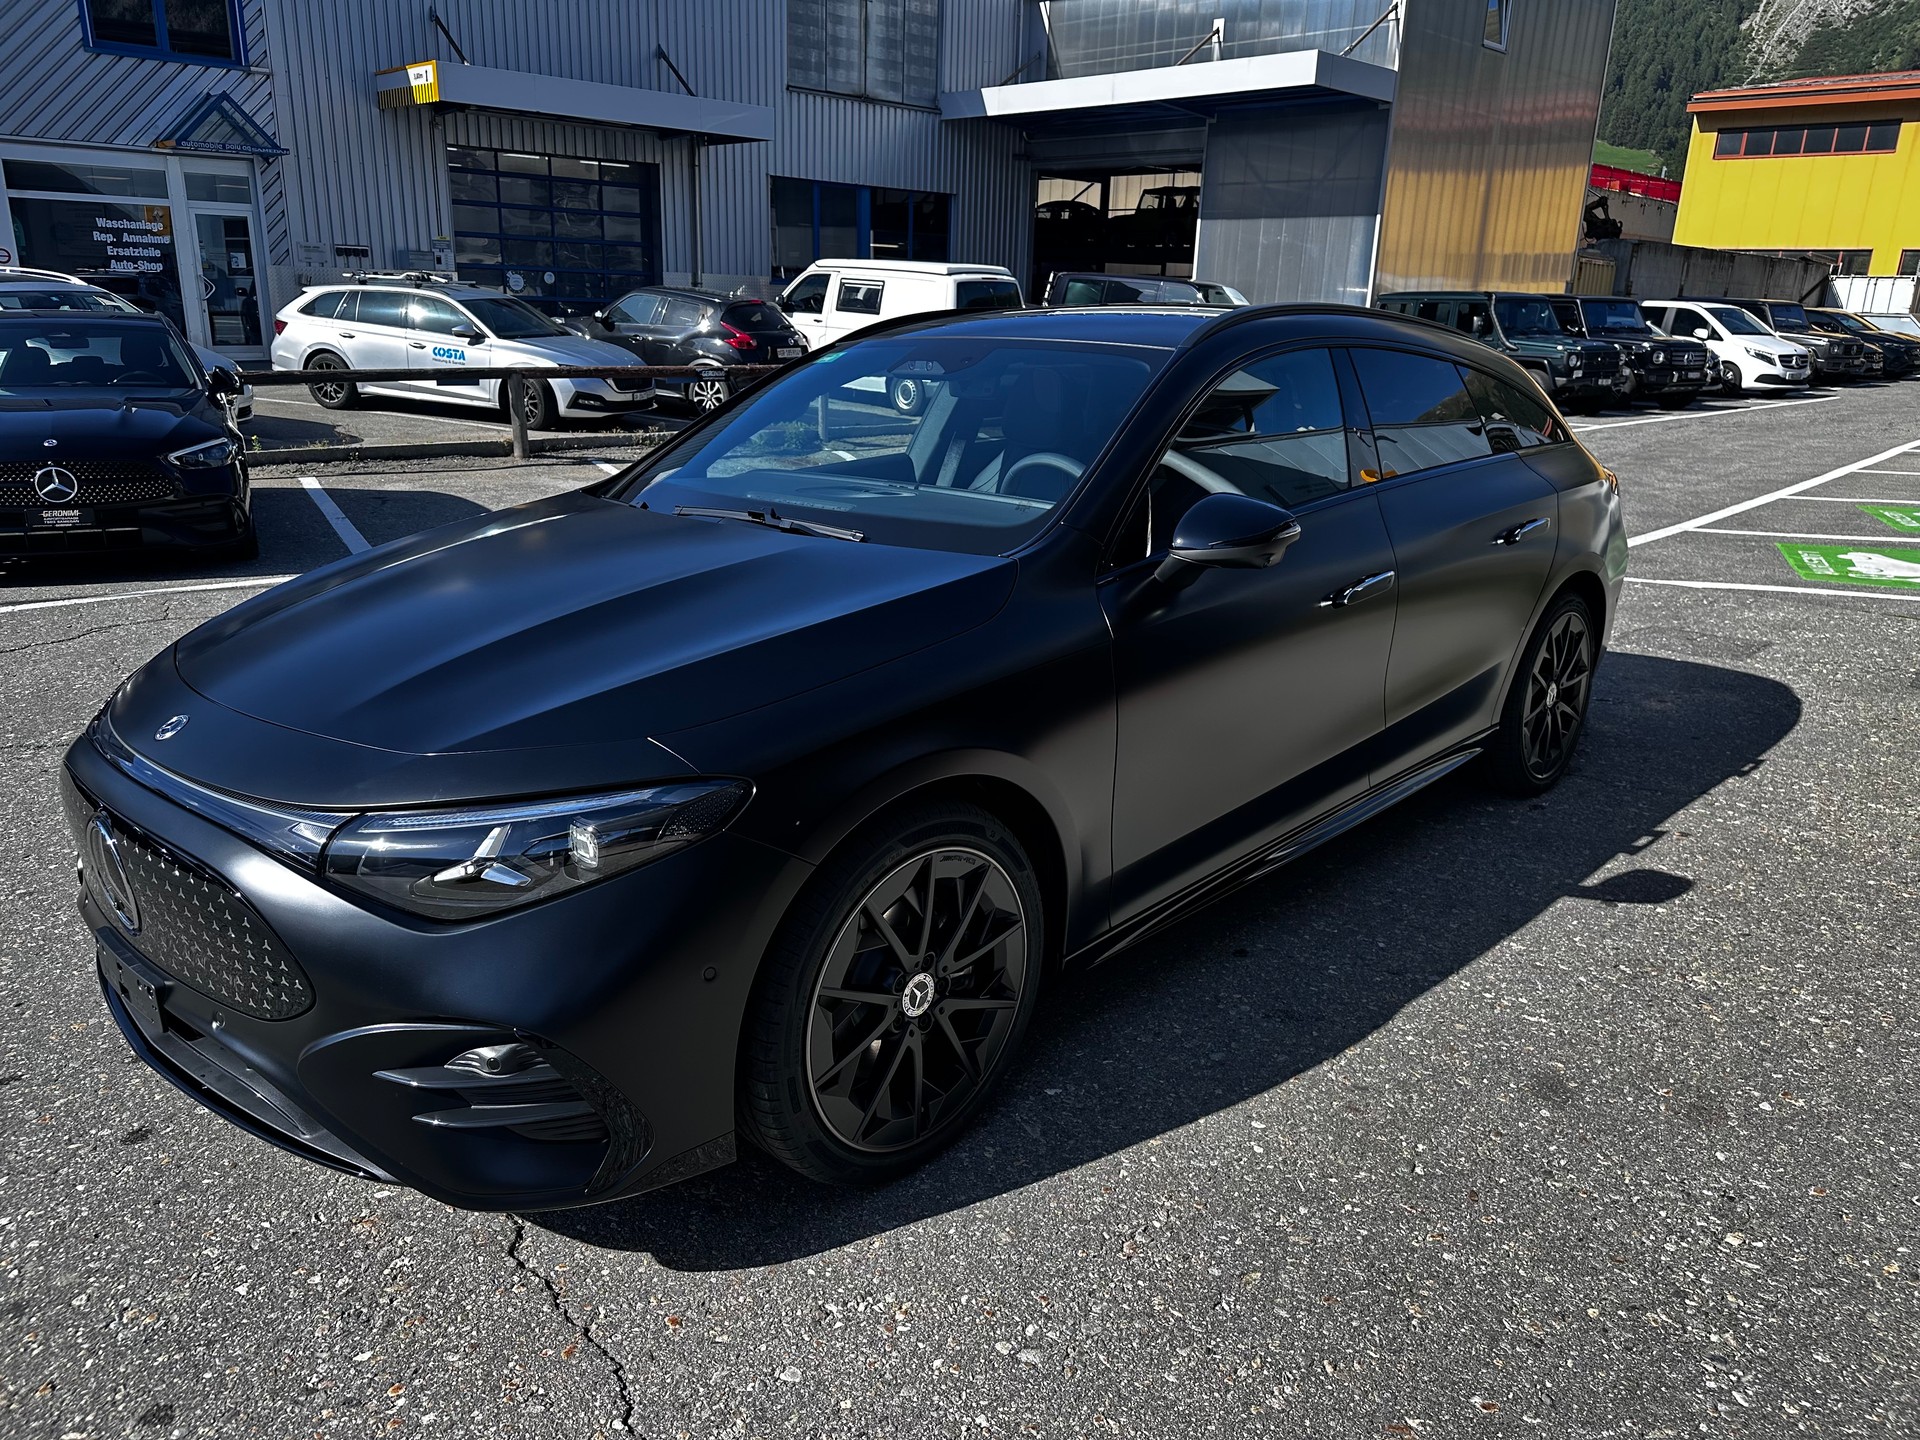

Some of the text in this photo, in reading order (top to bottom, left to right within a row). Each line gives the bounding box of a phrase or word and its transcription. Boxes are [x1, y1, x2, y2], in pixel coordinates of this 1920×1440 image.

[181, 140, 223, 150] automobile
[95, 217, 164, 232] Waschanlage
[92, 231, 171, 244] Rep. Annahme
[106, 245, 161, 257] Ersatzteile
[110, 259, 163, 272] Auto-Shop
[432, 346, 466, 360] COSTA
